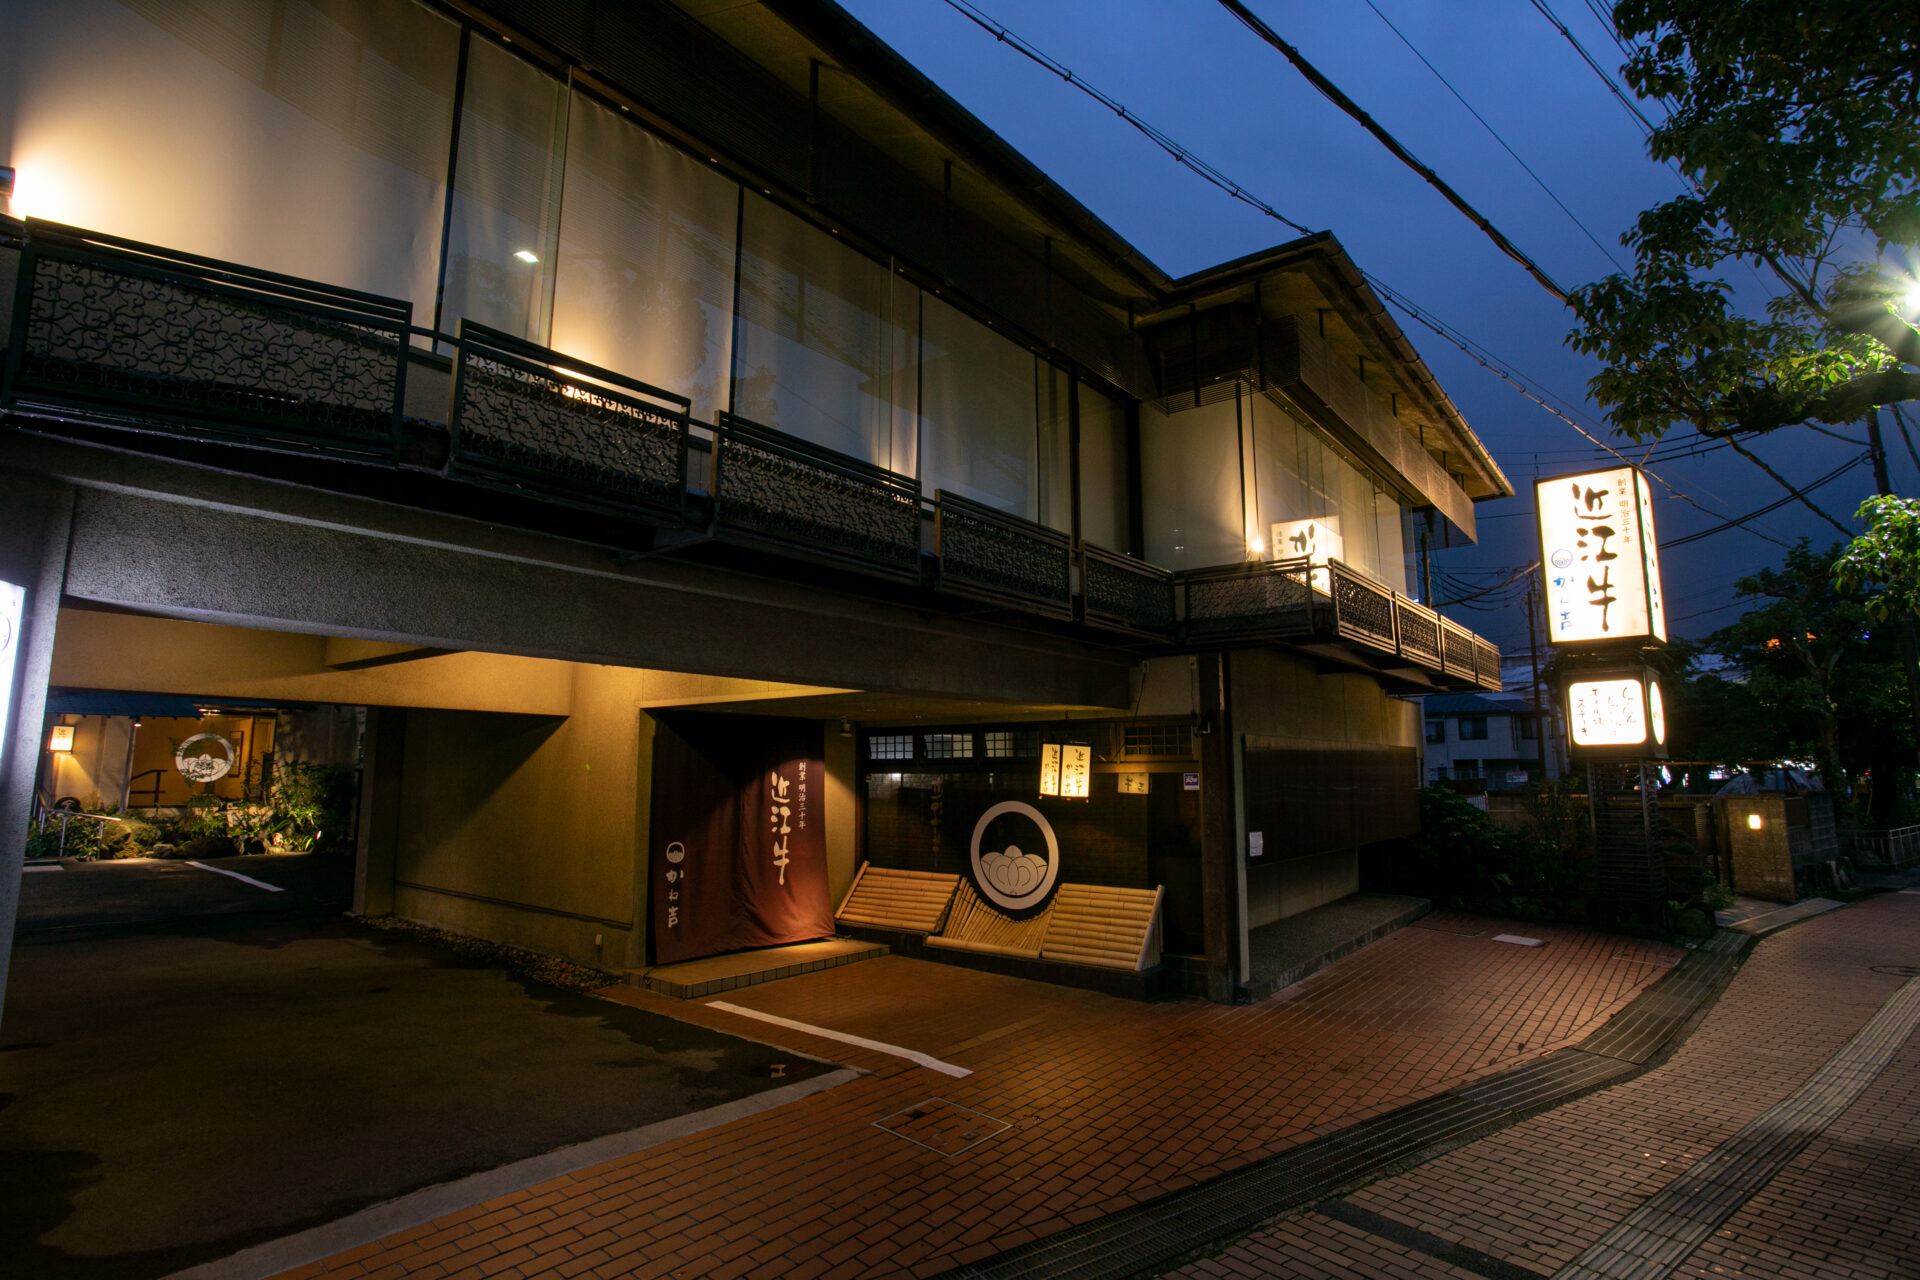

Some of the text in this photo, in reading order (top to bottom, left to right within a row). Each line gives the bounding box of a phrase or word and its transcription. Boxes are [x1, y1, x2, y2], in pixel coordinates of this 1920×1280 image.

[1572, 482, 1618, 632] 近江牛
[770, 771, 792, 886] 近江牛
[798, 783, 806, 830] 明治三十年
